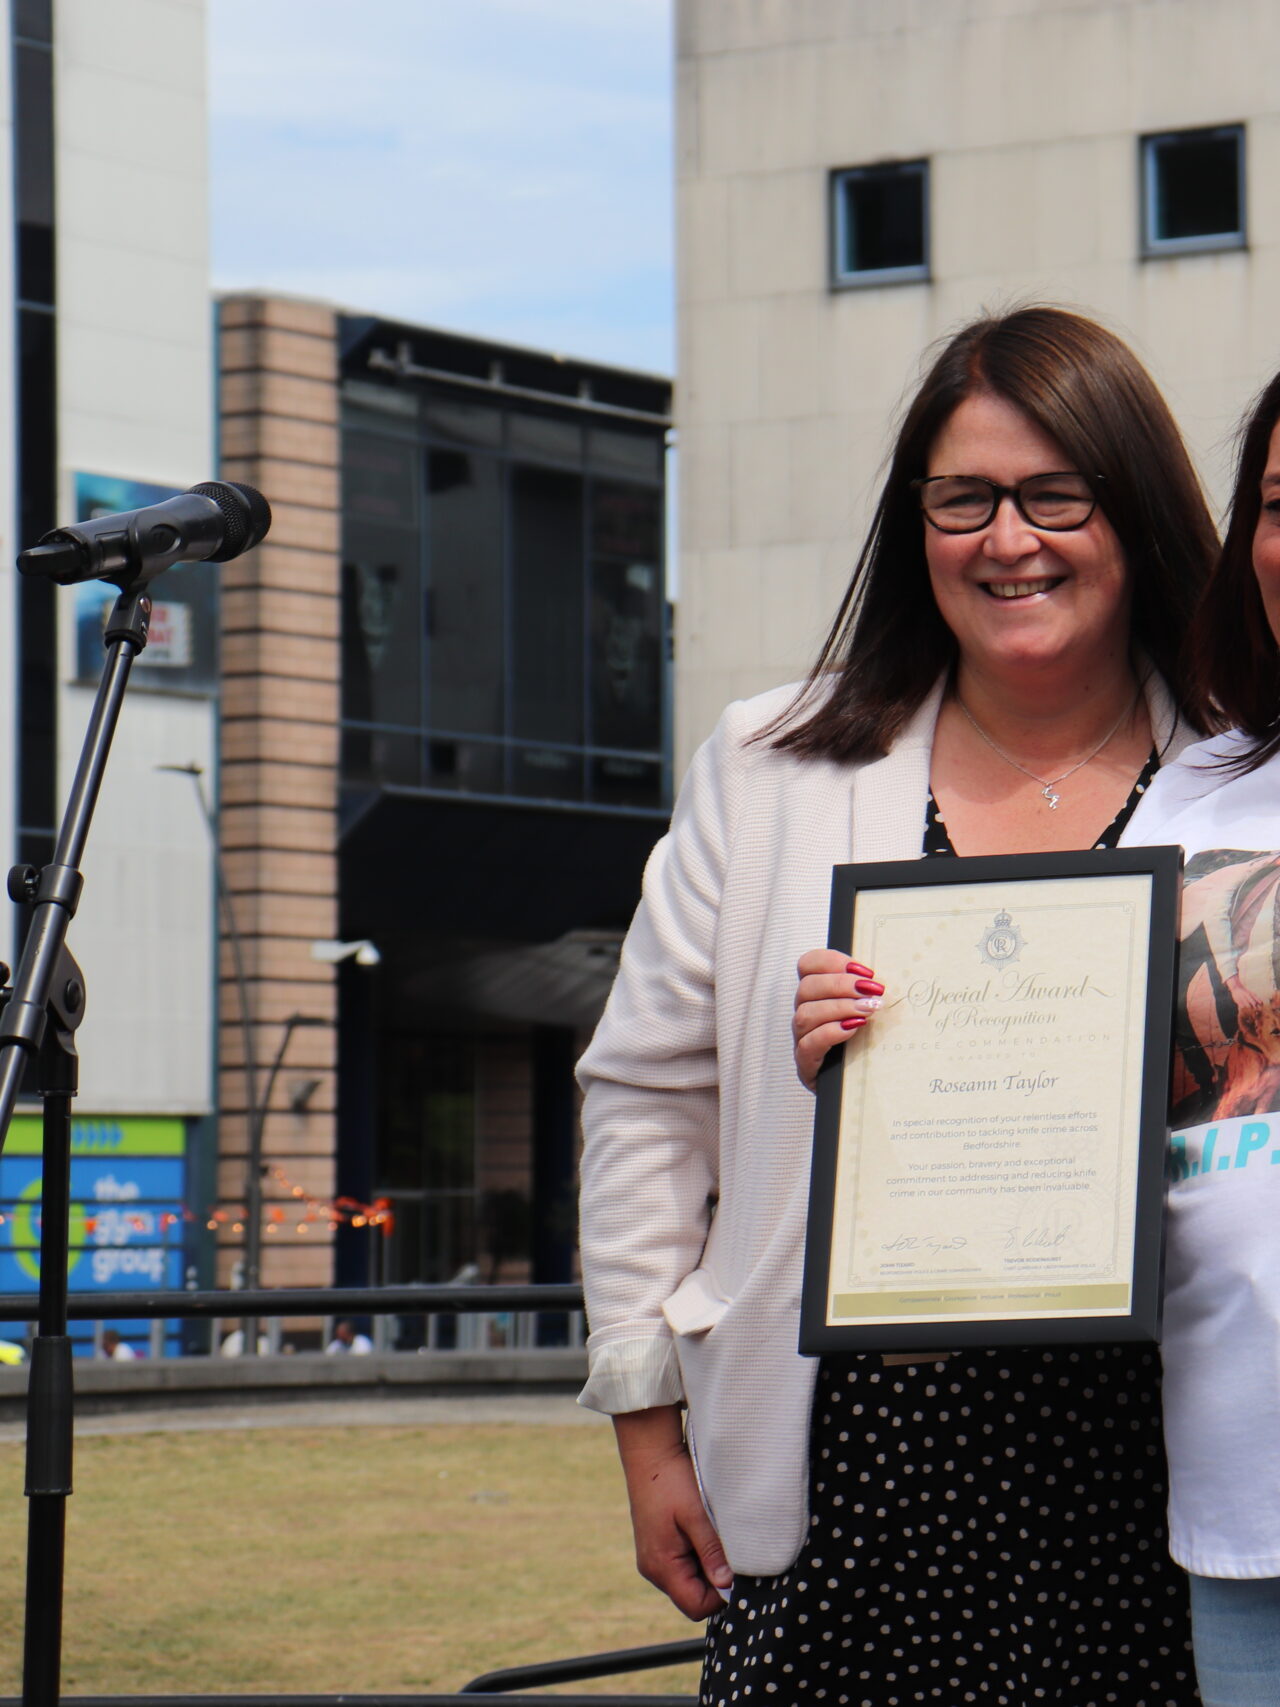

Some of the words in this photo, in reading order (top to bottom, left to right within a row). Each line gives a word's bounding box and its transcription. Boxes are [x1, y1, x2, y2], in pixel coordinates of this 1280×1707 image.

[888, 976, 991, 1016] Special
[994, 971, 1115, 1003] Award
[935, 1011, 952, 1037] of
[953, 1006, 1057, 1035] Recognition
[881, 1041, 942, 1051] FORCE
[956, 1034, 1111, 1049] COMMENDATION
[929, 1076, 998, 1094] Roseann
[1003, 1070, 1060, 1096] Taylor
[893, 1119, 902, 1127] In
[903, 1118, 934, 1128] special
[936, 1116, 987, 1127] recognition
[989, 1115, 999, 1123] of
[1000, 1115, 1021, 1125] your
[1023, 1113, 1066, 1121] relentless
[1068, 1111, 1097, 1119] efforts
[909, 1130, 965, 1139] contribution
[967, 1129, 977, 1137] to
[979, 1127, 1015, 1137] tackling
[1017, 1127, 1039, 1135] knife
[1041, 1126, 1067, 1134] crime
[908, 1163, 929, 1171] Your
[968, 1159, 1001, 1170] bravery
[1024, 1156, 1076, 1166] exceptional
[886, 1176, 945, 1185] commitment
[949, 1174, 957, 1182] to
[959, 1172, 1009, 1183] addressing
[1011, 1171, 1028, 1179] and
[1031, 1169, 1071, 1180] reducing
[1074, 1169, 1096, 1177] knife
[94, 1174, 140, 1201] the
[889, 1189, 915, 1198] crime
[917, 1189, 926, 1197] in
[945, 1186, 998, 1196] community
[1000, 1185, 1016, 1193] has
[1018, 1184, 1041, 1192] been
